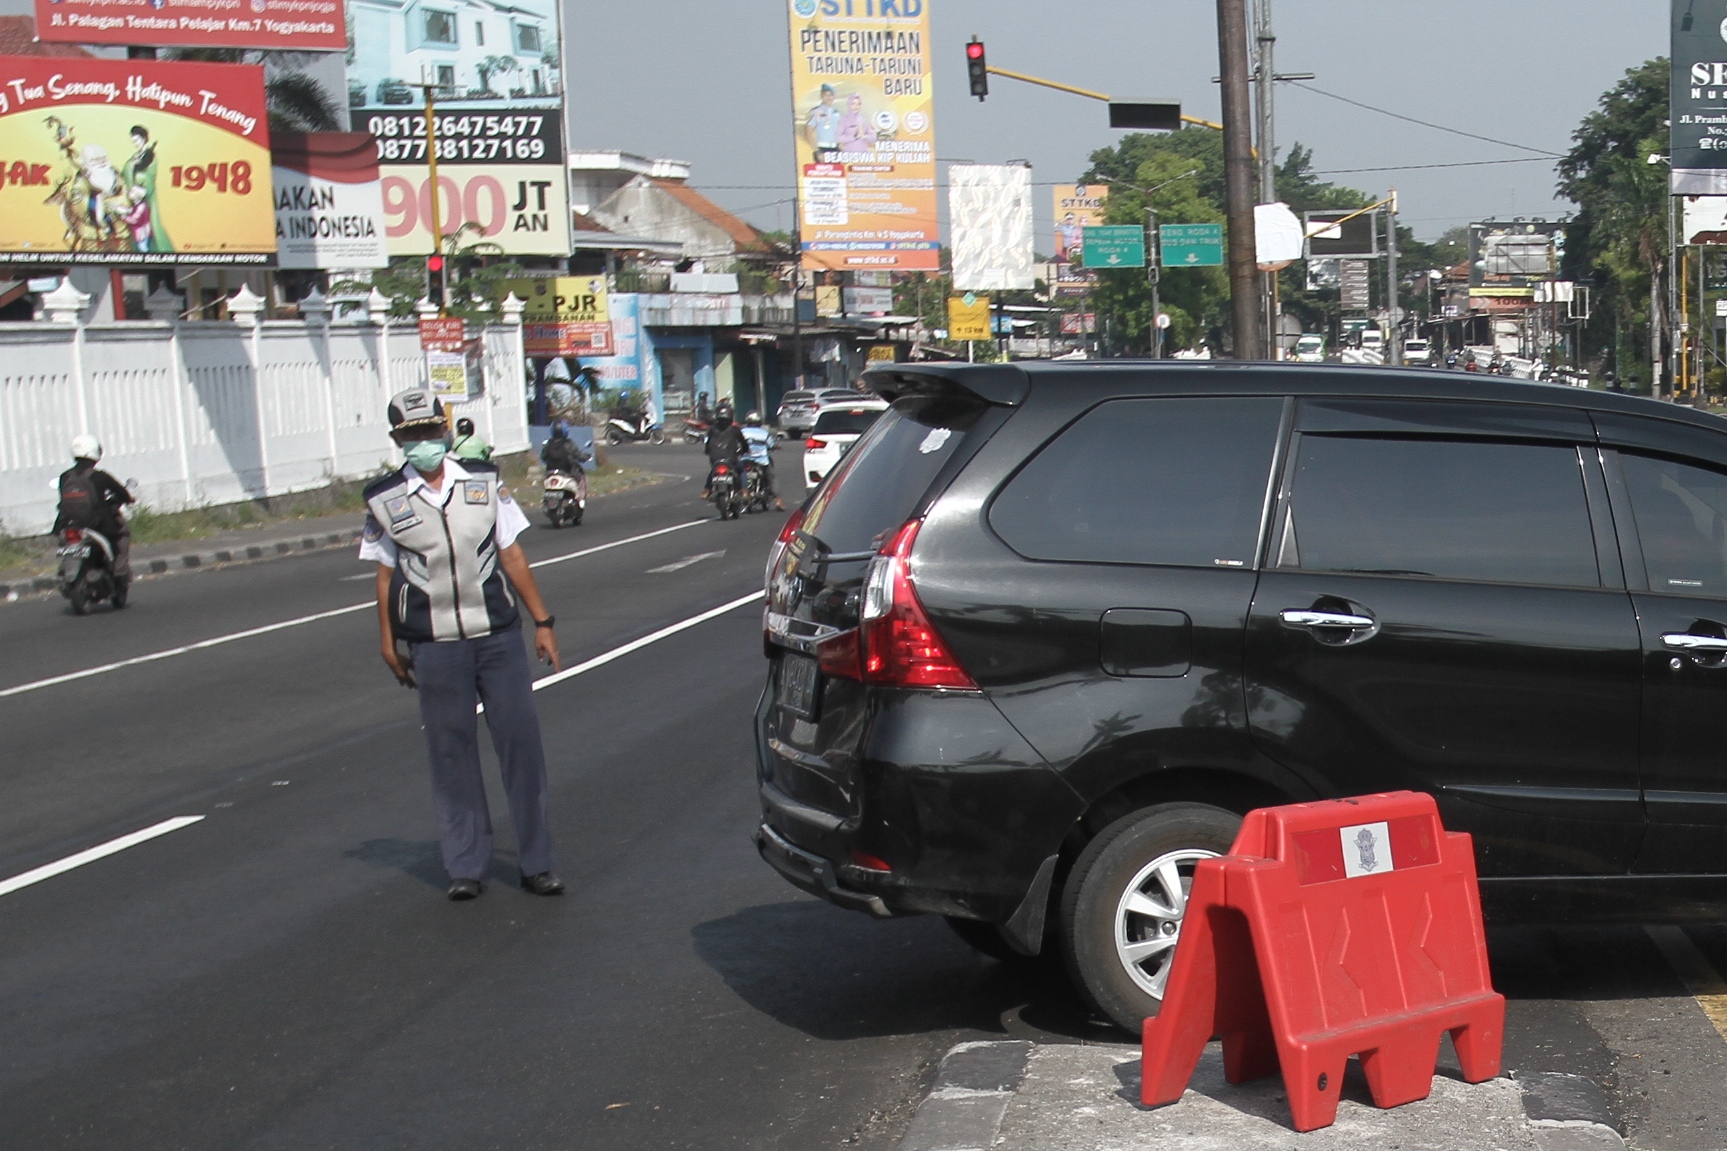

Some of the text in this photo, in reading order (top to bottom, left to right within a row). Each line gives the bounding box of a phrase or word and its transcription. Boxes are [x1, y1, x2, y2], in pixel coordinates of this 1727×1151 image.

[821, 0, 922, 17] STTKD
[68, 13, 125, 30] Palagan
[126, 15, 177, 29] Tentara
[180, 17, 226, 32] Pelajar
[264, 19, 336, 34] Yogyakarta
[800, 30, 921, 54] PENERIMAAN
[807, 56, 921, 74] TARUNA-TARUNI
[884, 78, 921, 95] BARU
[7, 78, 45, 105] Tua
[47, 74, 121, 103] Senang,
[125, 75, 193, 109] Hatipun
[199, 90, 257, 135] Tenang
[368, 115, 544, 137] 081226475477
[1679, 115, 1692, 124] Jl.
[875, 141, 930, 152] MENERIMA
[170, 160, 252, 196] 1948
[383, 175, 552, 238] 900 JT
[290, 215, 376, 239] INDONESIA
[513, 213, 549, 232] AN
[553, 295, 596, 312] PJR
